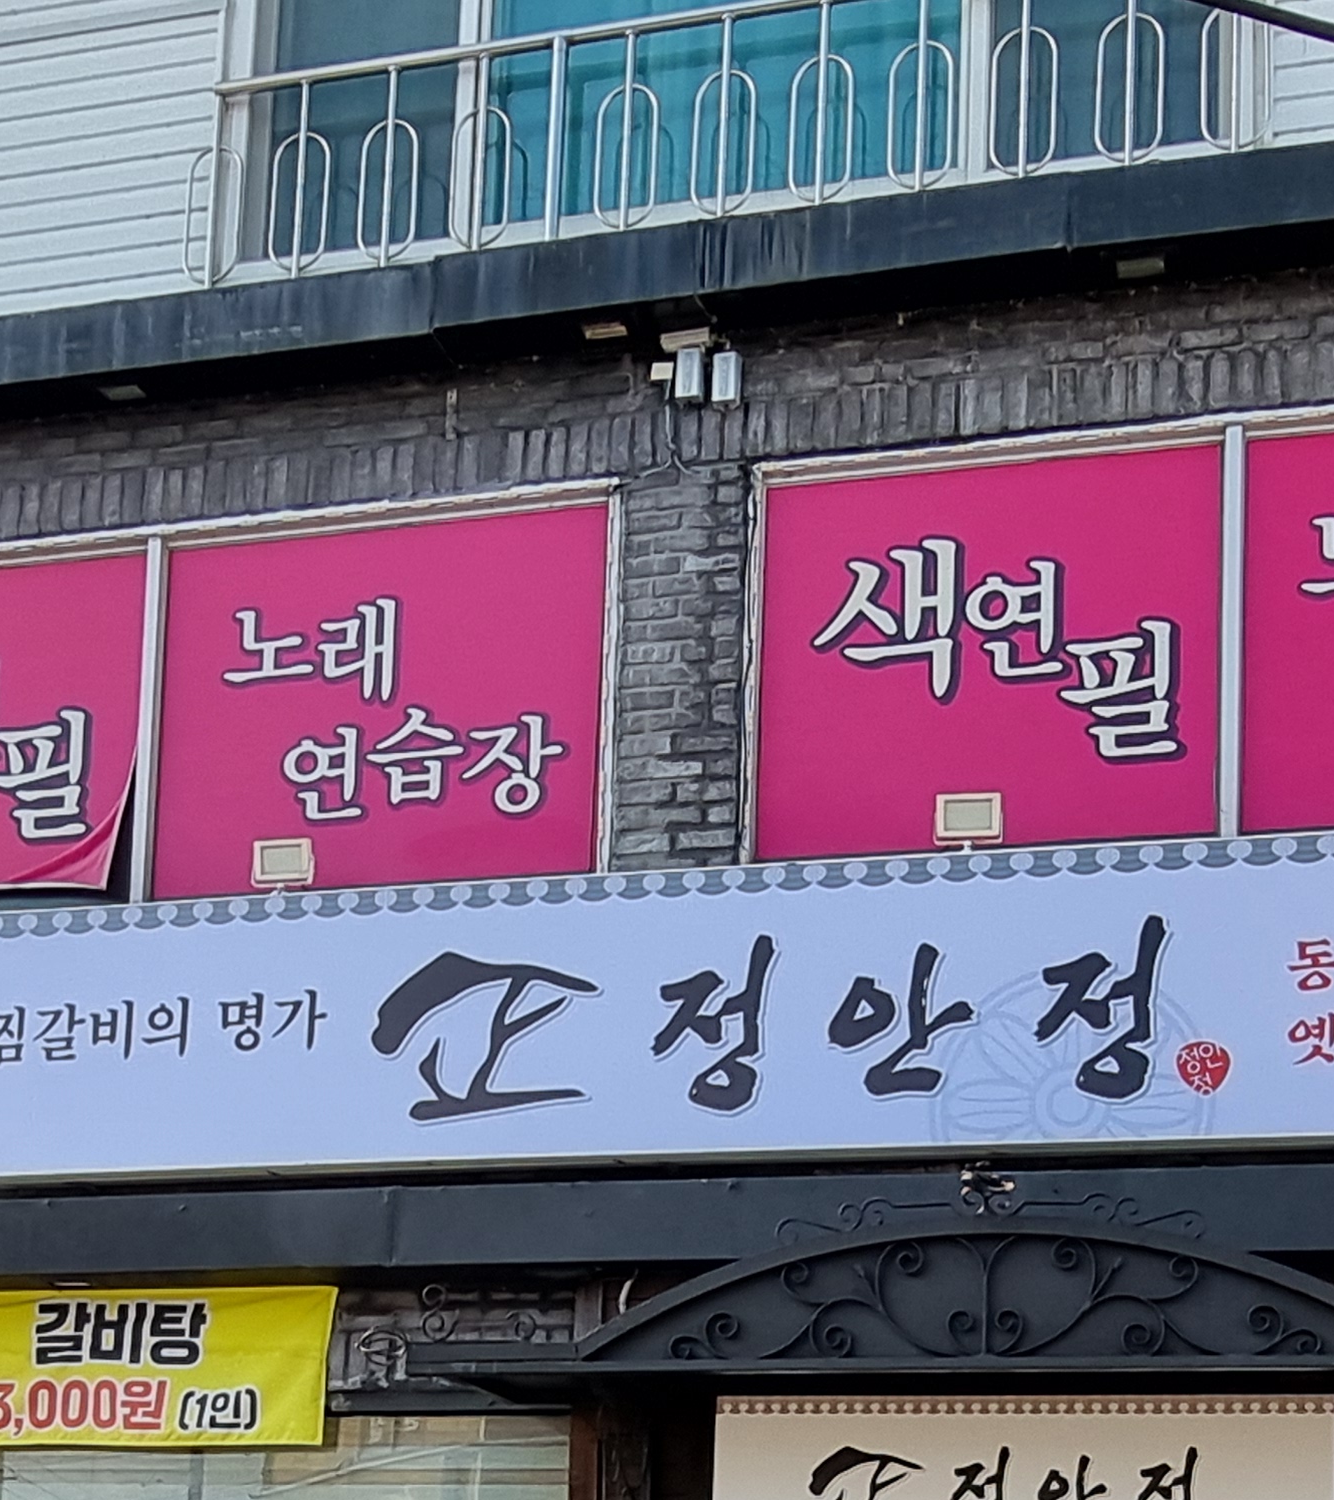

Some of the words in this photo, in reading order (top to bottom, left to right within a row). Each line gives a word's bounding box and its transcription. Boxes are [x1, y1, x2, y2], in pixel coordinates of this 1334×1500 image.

[223, 598, 400, 703] 노래
[812, 539, 1182, 759] 색연필
[282, 707, 564, 821] 연습장
[218, 989, 328, 1051] 명가
[34, 1303, 207, 1367] 갈비탕
[178, 1388, 259, 1431] (1인)
